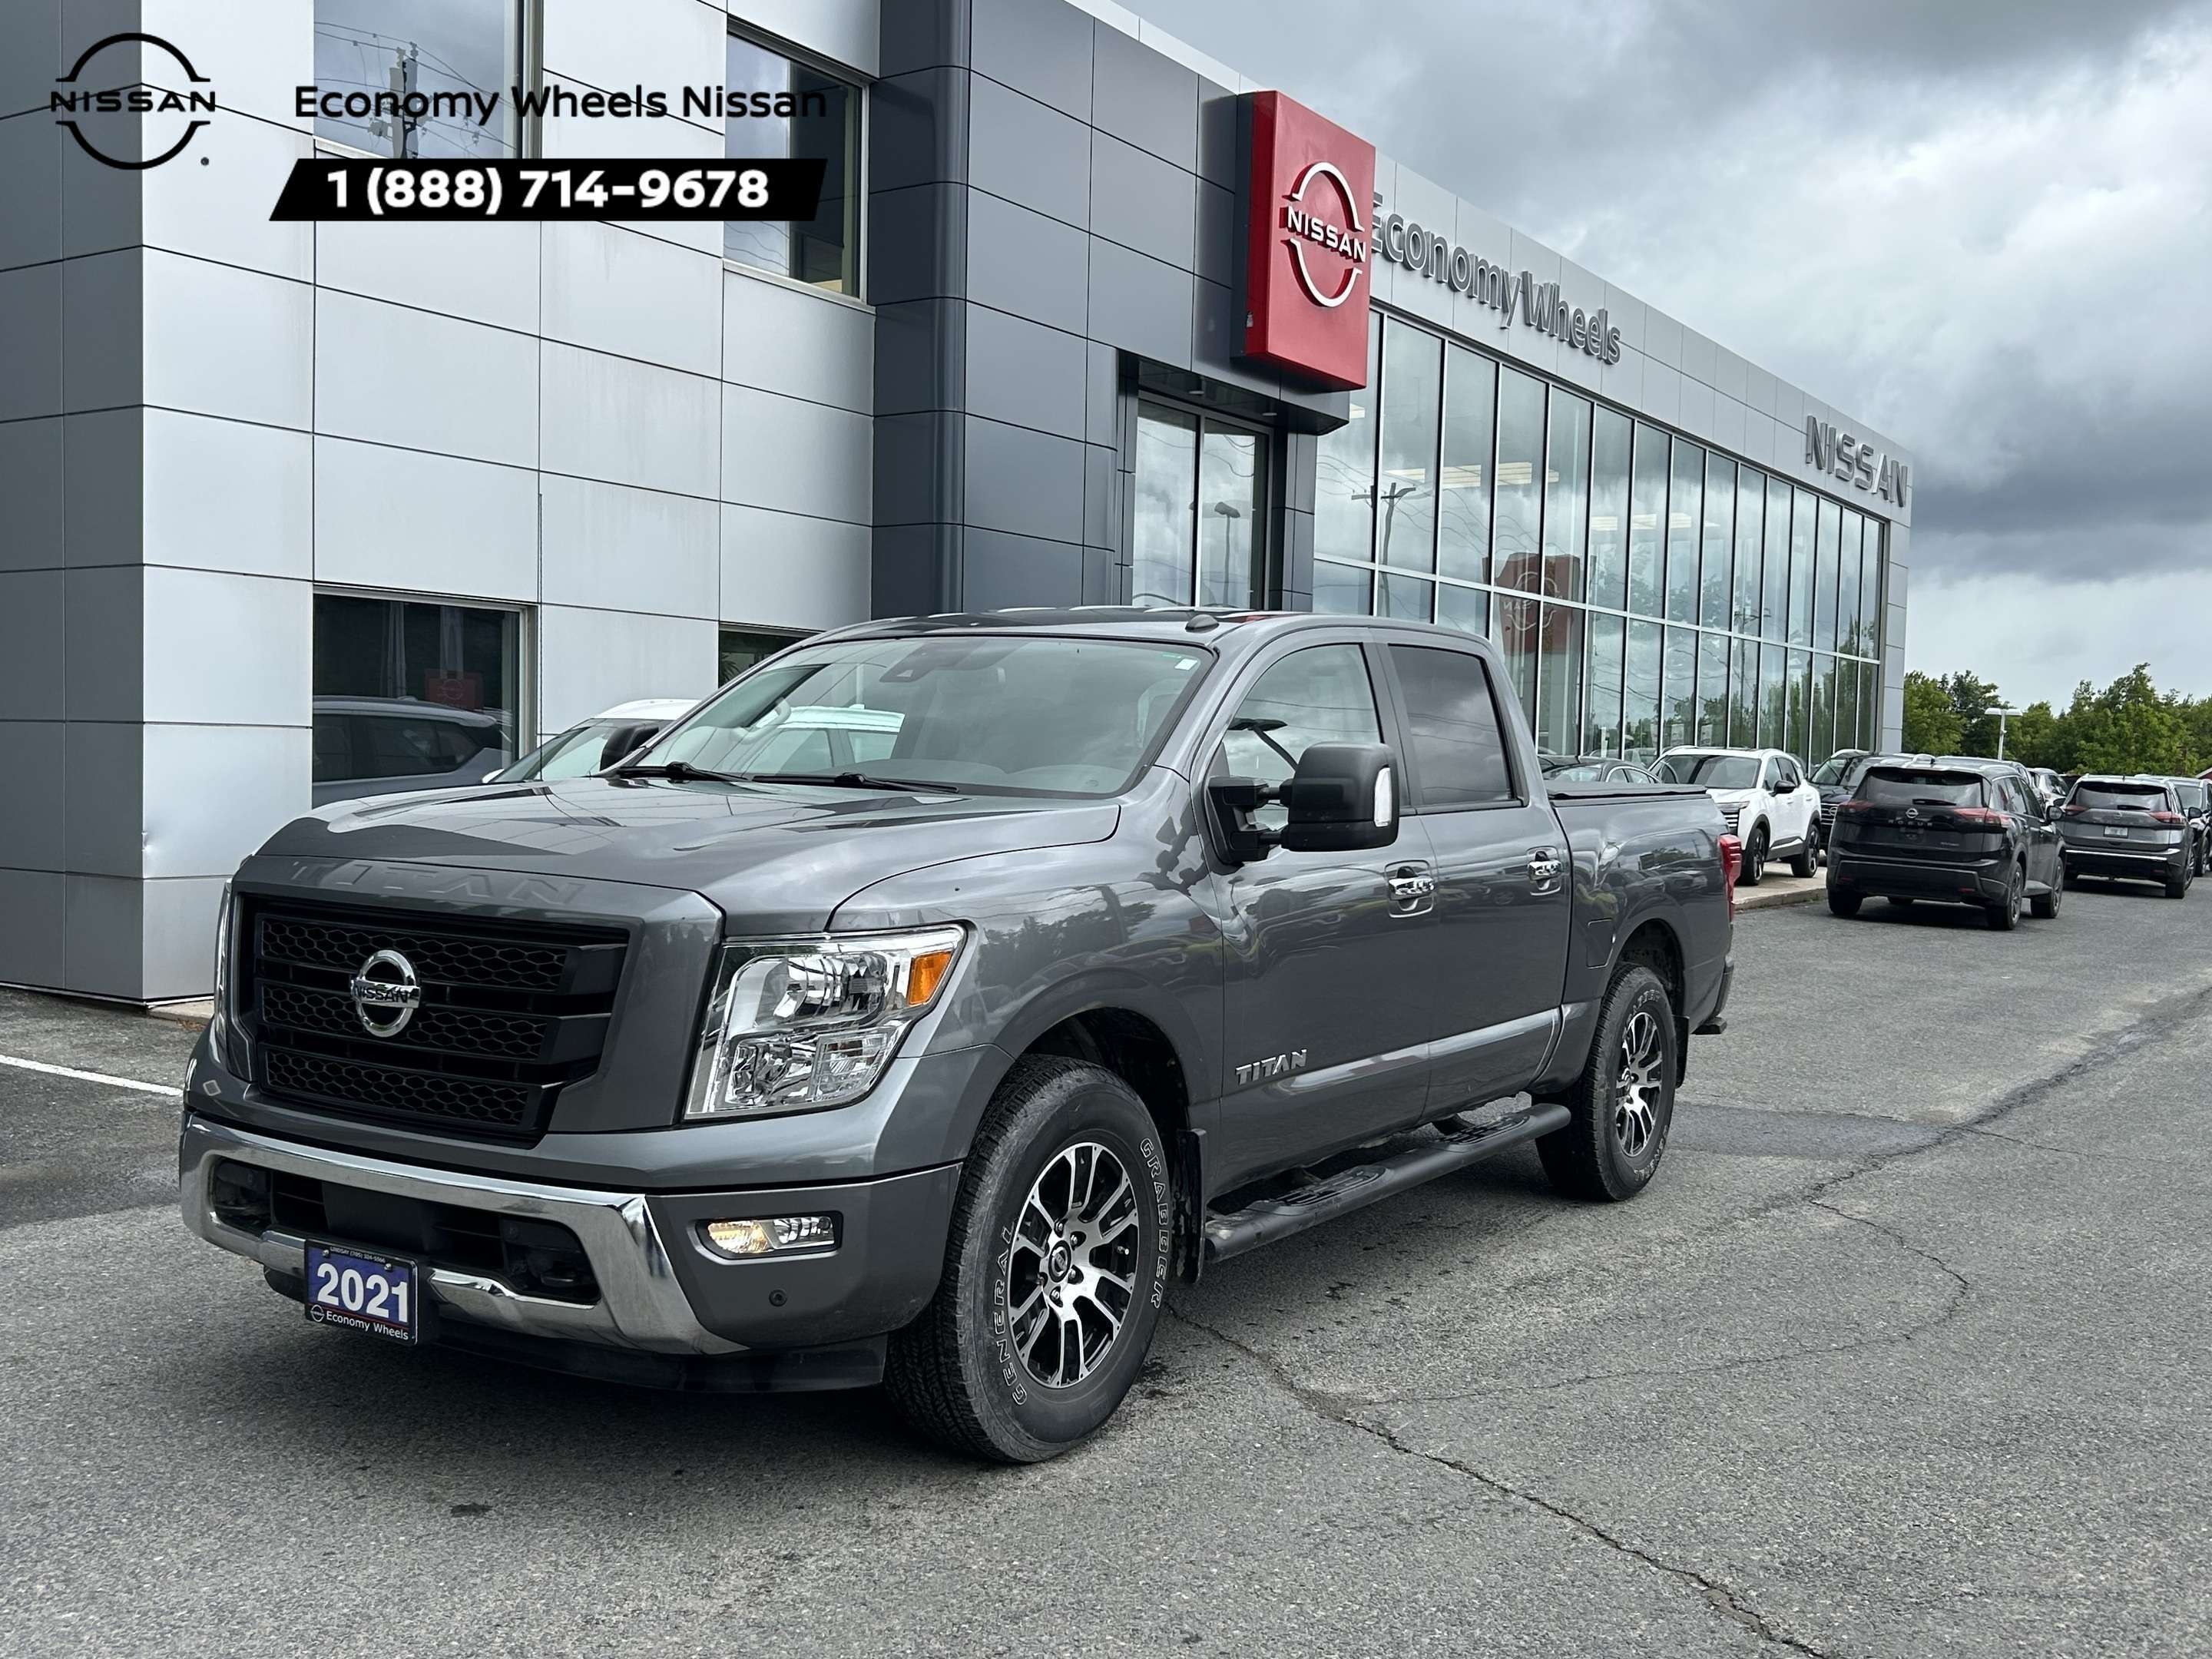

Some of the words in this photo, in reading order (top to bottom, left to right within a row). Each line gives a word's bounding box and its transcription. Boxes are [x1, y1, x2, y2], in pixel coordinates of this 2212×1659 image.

[1287, 205, 1367, 263] NISSAN
[1522, 270, 1621, 364] Wheels
[1806, 415, 1908, 508] NISSAN
[353, 985, 410, 1003] NISSAN
[1235, 1049, 1307, 1086] TITAN
[1140, 1137, 1170, 1309] GRABBER
[316, 1263, 409, 1323] 2021
[994, 1220, 1028, 1406] GENERAL
[326, 1310, 370, 1332] Economy
[373, 1322, 409, 1340] Wheels
